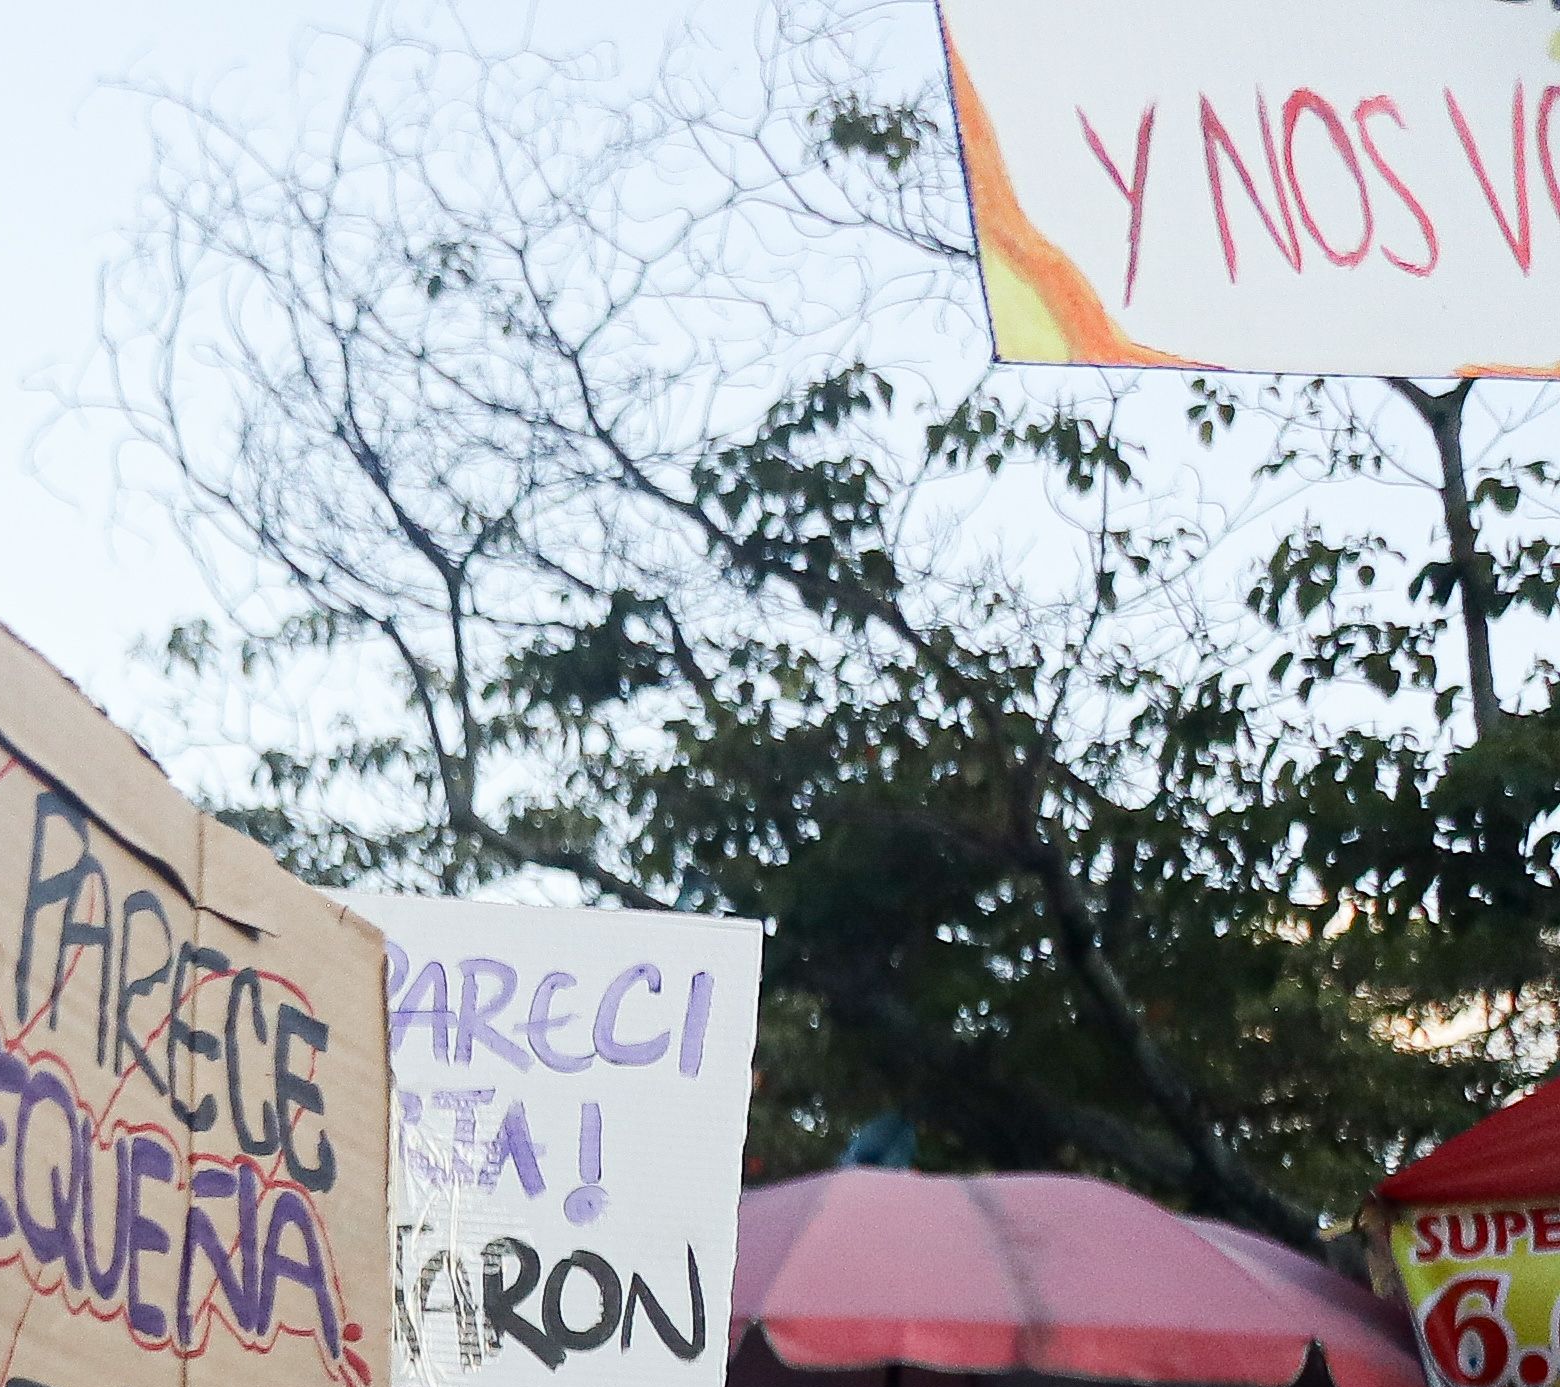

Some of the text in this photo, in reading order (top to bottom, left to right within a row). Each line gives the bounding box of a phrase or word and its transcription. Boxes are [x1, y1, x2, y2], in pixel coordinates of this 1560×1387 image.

[1074, 77, 1560, 310] Y NOS V
[16, 791, 339, 1192] PARECE
[1423, 1278, 1560, 1387] 6.
